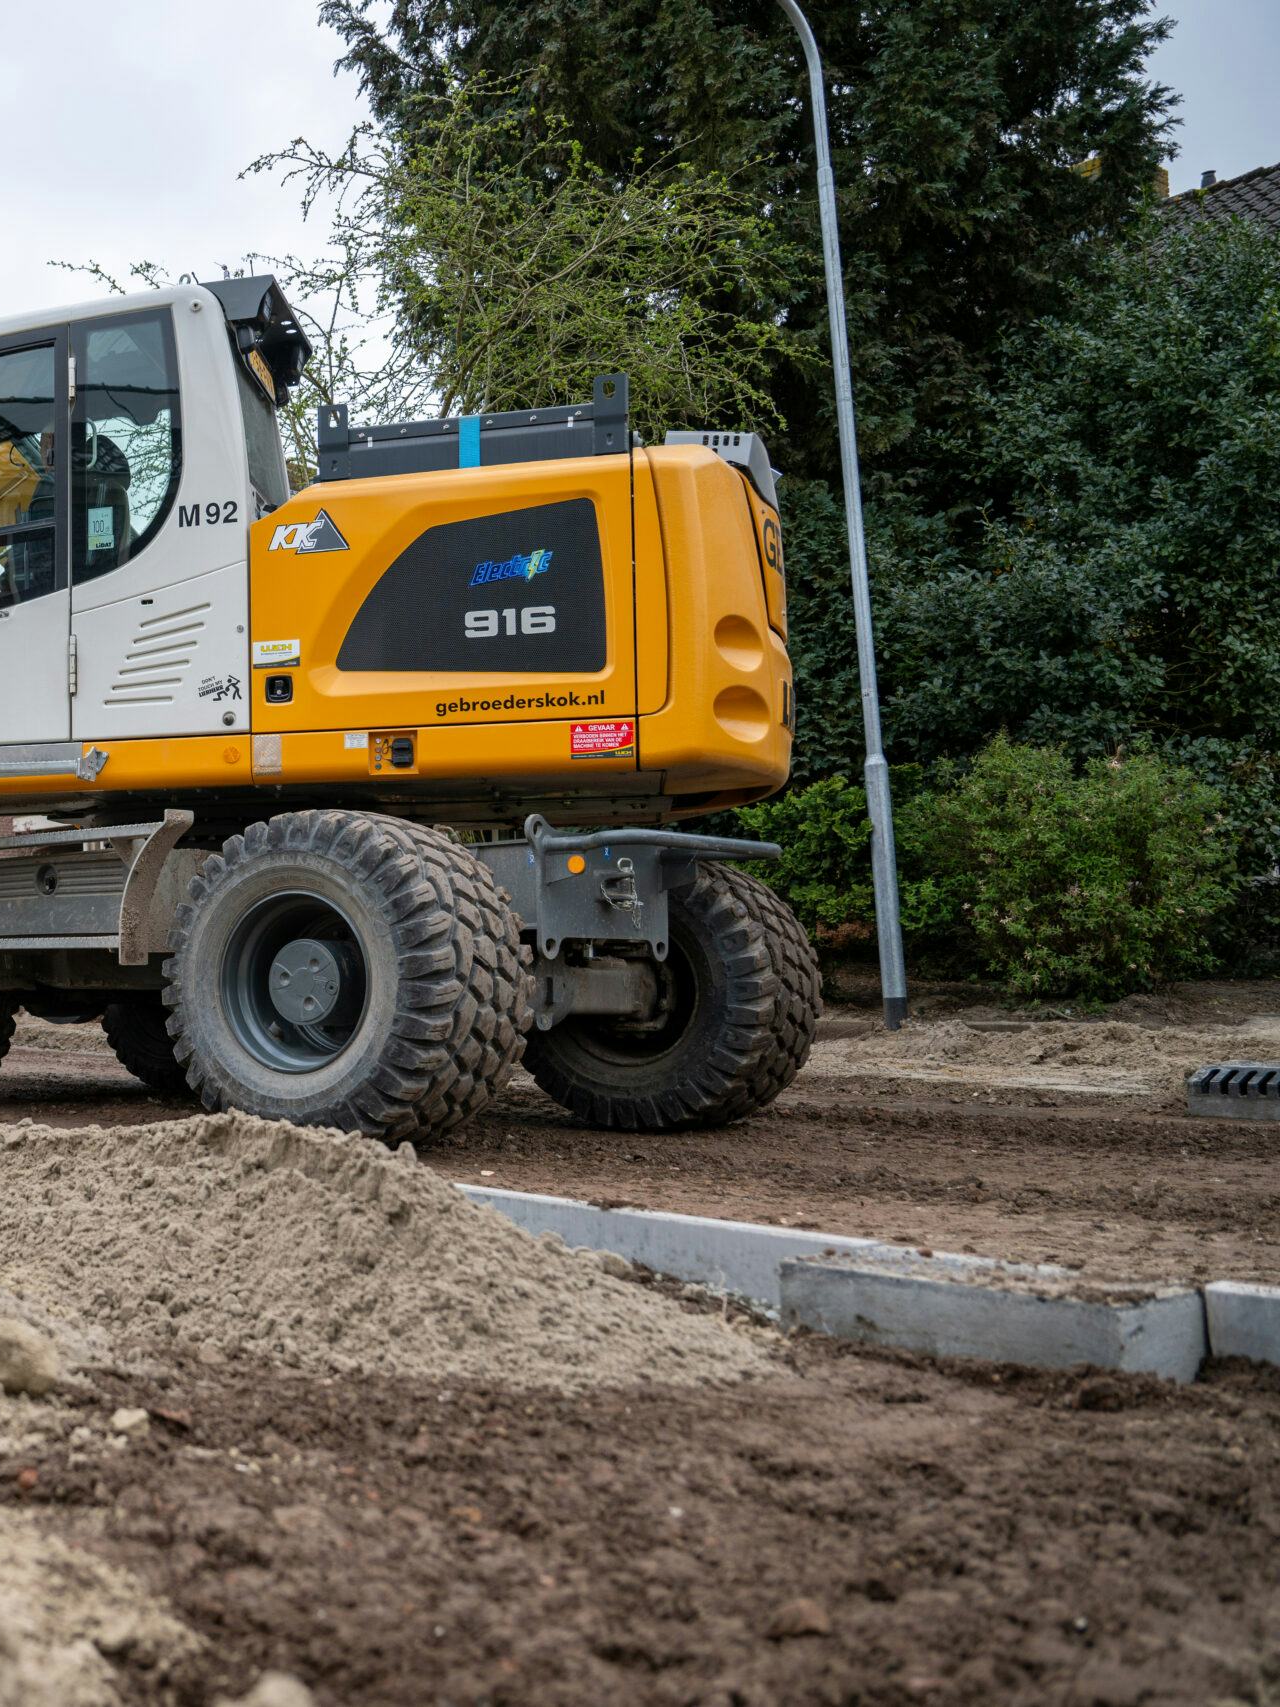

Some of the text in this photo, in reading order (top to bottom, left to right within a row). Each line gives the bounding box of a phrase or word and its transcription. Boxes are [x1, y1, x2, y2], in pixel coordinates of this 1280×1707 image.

[93, 520, 104, 533] 100
[464, 605, 556, 638] 916
[435, 690, 605, 716] gebroederskok.nl
